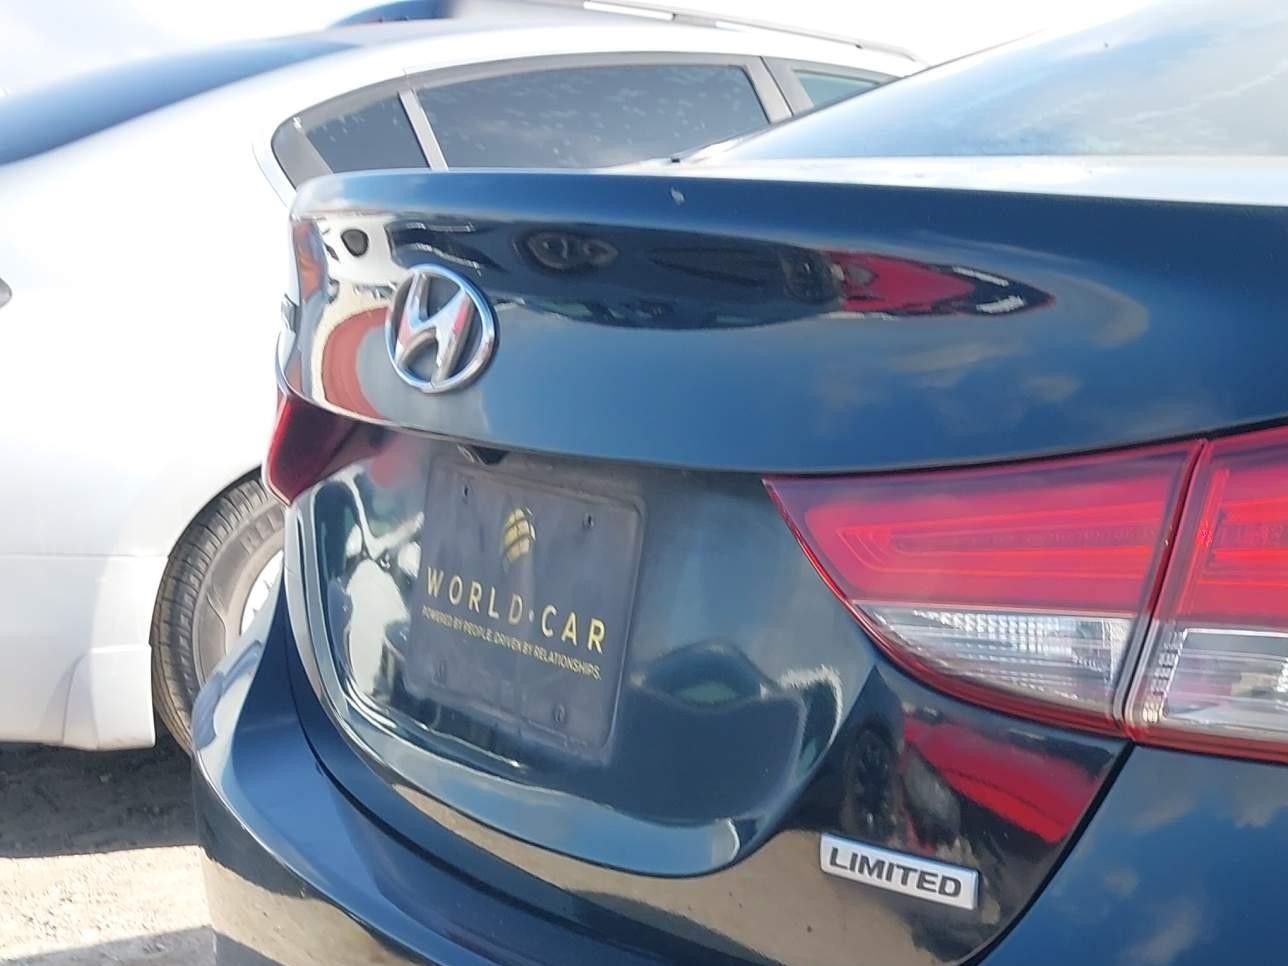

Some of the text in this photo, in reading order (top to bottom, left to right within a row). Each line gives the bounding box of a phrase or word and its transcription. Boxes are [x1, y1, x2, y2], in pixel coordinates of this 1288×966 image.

[427, 567, 606, 654] WORLD CAR
[829, 846, 962, 898] LIMITED
